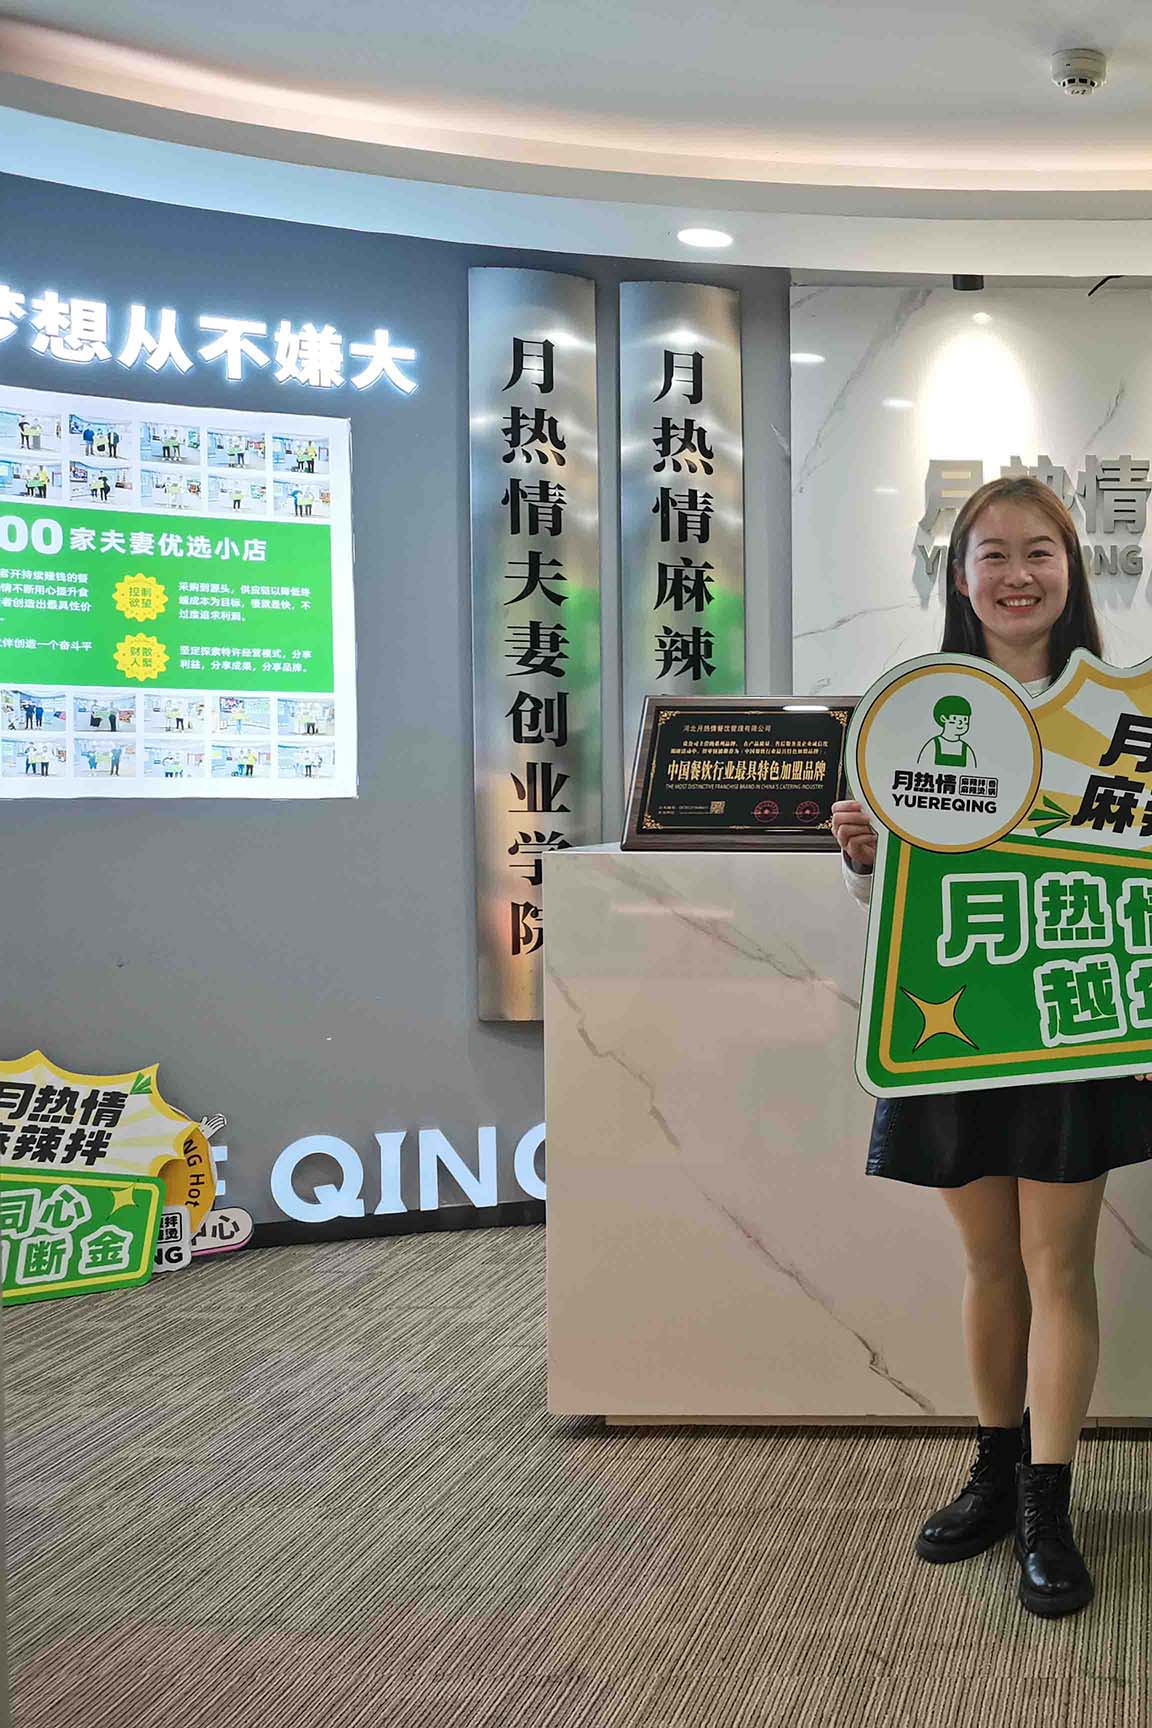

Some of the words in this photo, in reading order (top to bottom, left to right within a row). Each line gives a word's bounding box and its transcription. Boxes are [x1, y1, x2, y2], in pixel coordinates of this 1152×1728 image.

[652, 349, 717, 681] 月热情麻辣
[0, 638, 92, 652] 伴创造一个奋斗平
[667, 759, 827, 781] 中国餐饮行业最具特色加盟品牌
[892, 769, 957, 795] 月热情
[892, 793, 997, 814] YUEREQING
[0, 1122, 112, 1166] 辣拌
[0, 1224, 133, 1285] 断金
